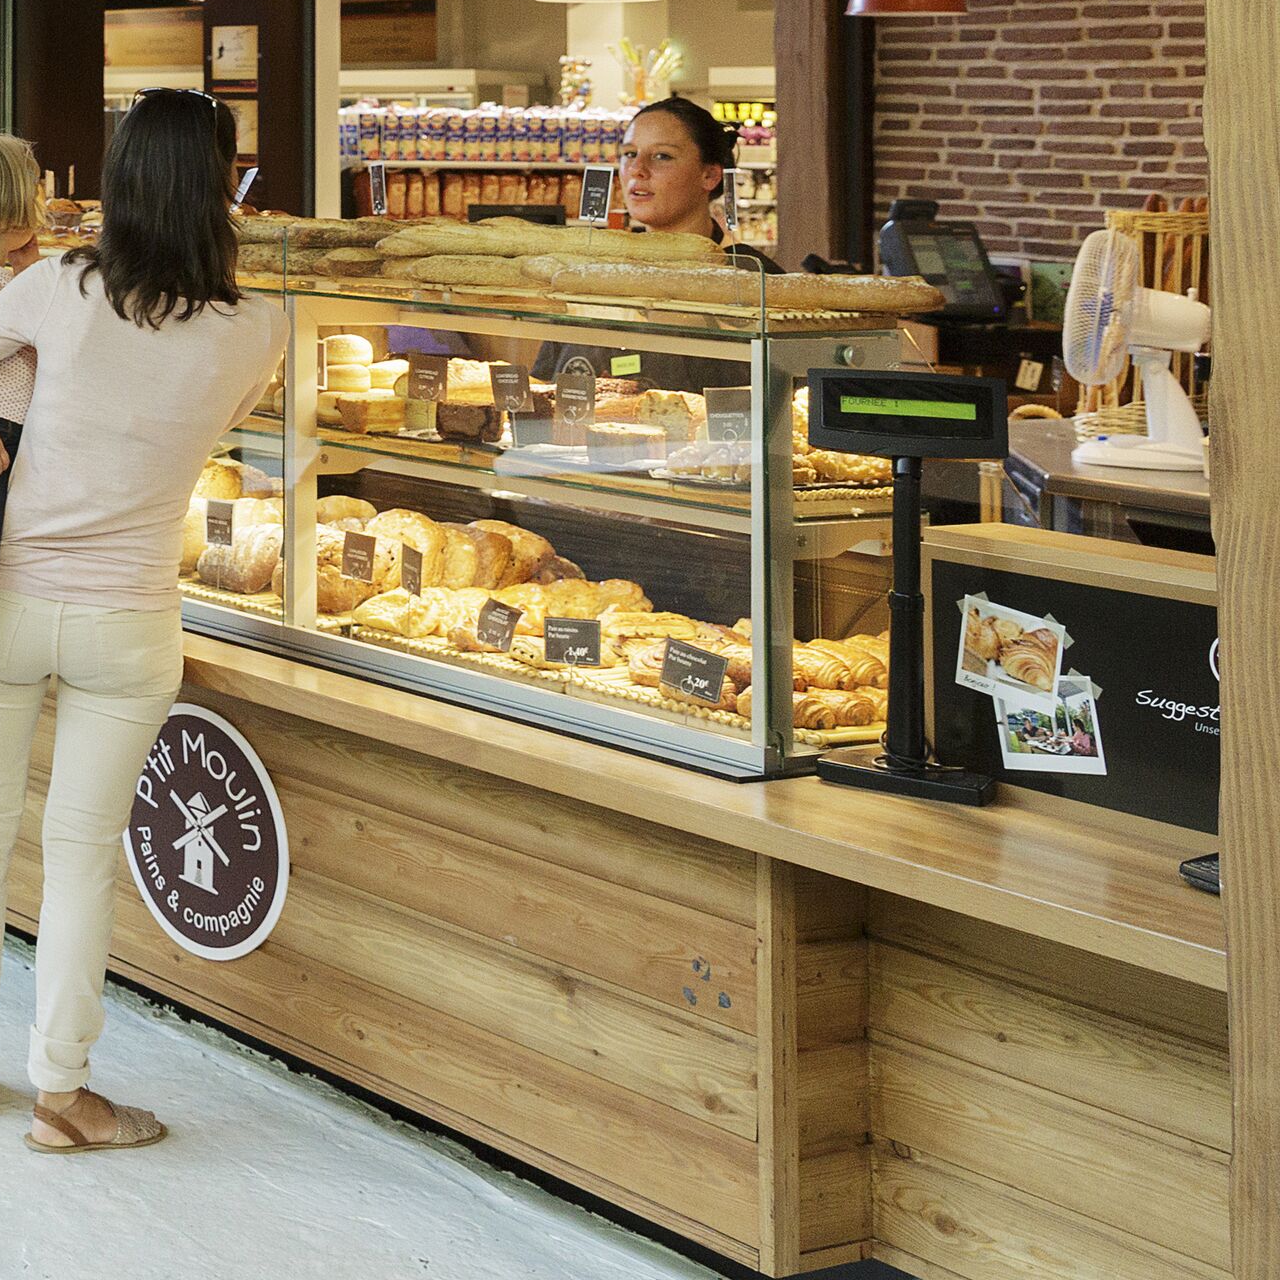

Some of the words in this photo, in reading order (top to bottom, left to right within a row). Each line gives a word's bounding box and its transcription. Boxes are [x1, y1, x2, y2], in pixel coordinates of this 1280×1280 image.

[1135, 689, 1220, 721] Suggest
[1194, 722, 1220, 735] Unse
[181, 729, 262, 852] Moulin
[137, 826, 166, 891] Pains
[167, 889, 179, 912] &
[183, 875, 265, 936] compagnie
